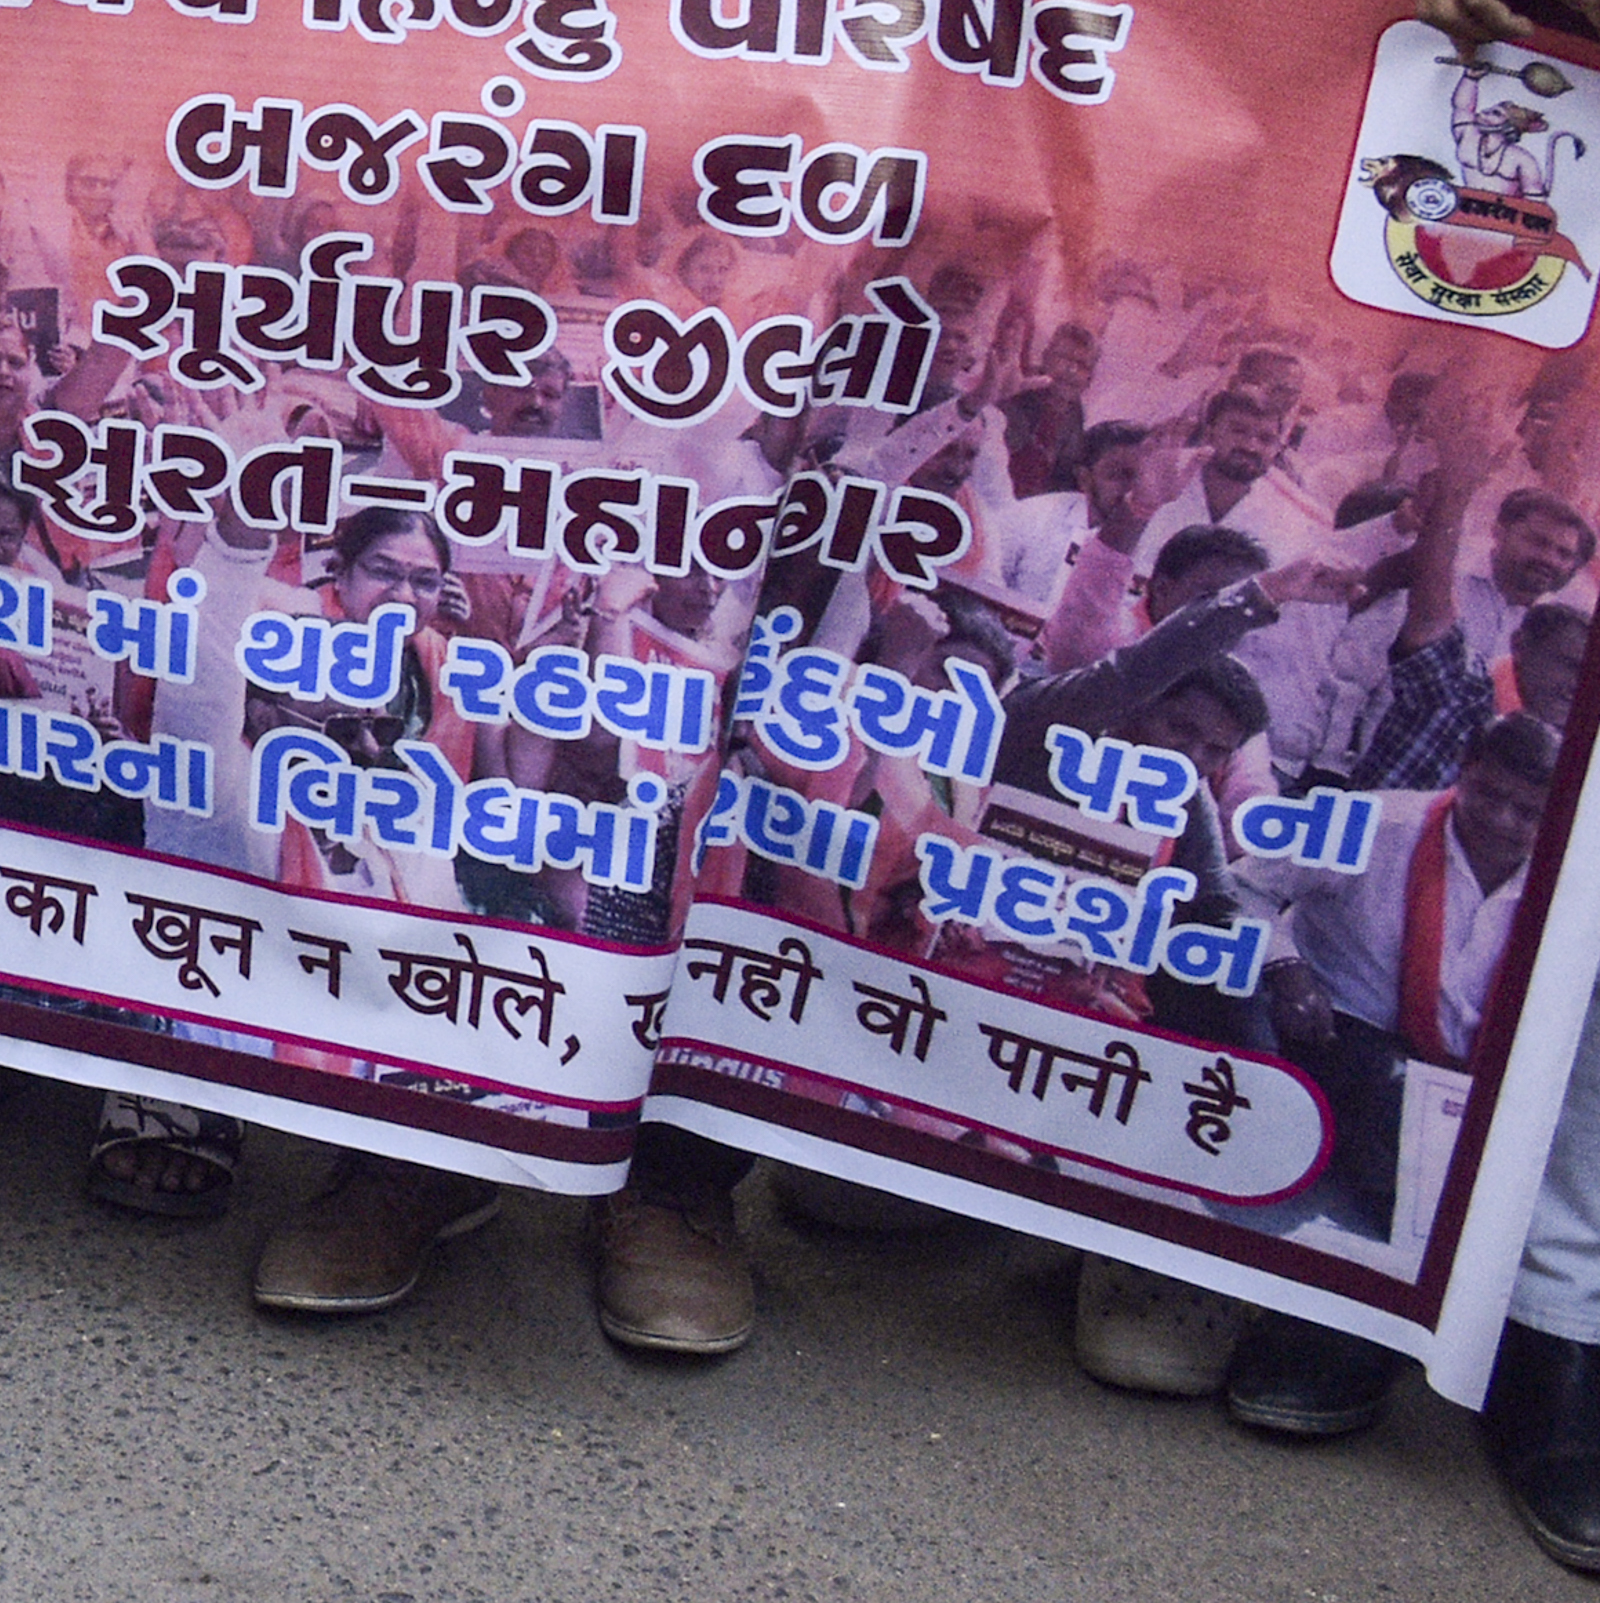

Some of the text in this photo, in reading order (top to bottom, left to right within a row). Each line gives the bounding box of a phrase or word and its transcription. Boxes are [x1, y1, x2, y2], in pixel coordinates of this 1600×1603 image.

[166, 77, 928, 250] બજરંગ દળ
[87, 567, 208, 686] માં
[238, 602, 414, 706] થઈ
[1046, 722, 1204, 836] પર
[1232, 789, 1382, 874] ના
[249, 727, 663, 894] વિરોધમાં
[0, 864, 99, 946] का
[126, 890, 260, 999] खून
[287, 929, 353, 999] न
[378, 934, 582, 1066] खोले,
[684, 937, 823, 1025] नही
[852, 974, 946, 1063] वो
[981, 1023, 1151, 1126] पानी
[1182, 1055, 1252, 1156] है
